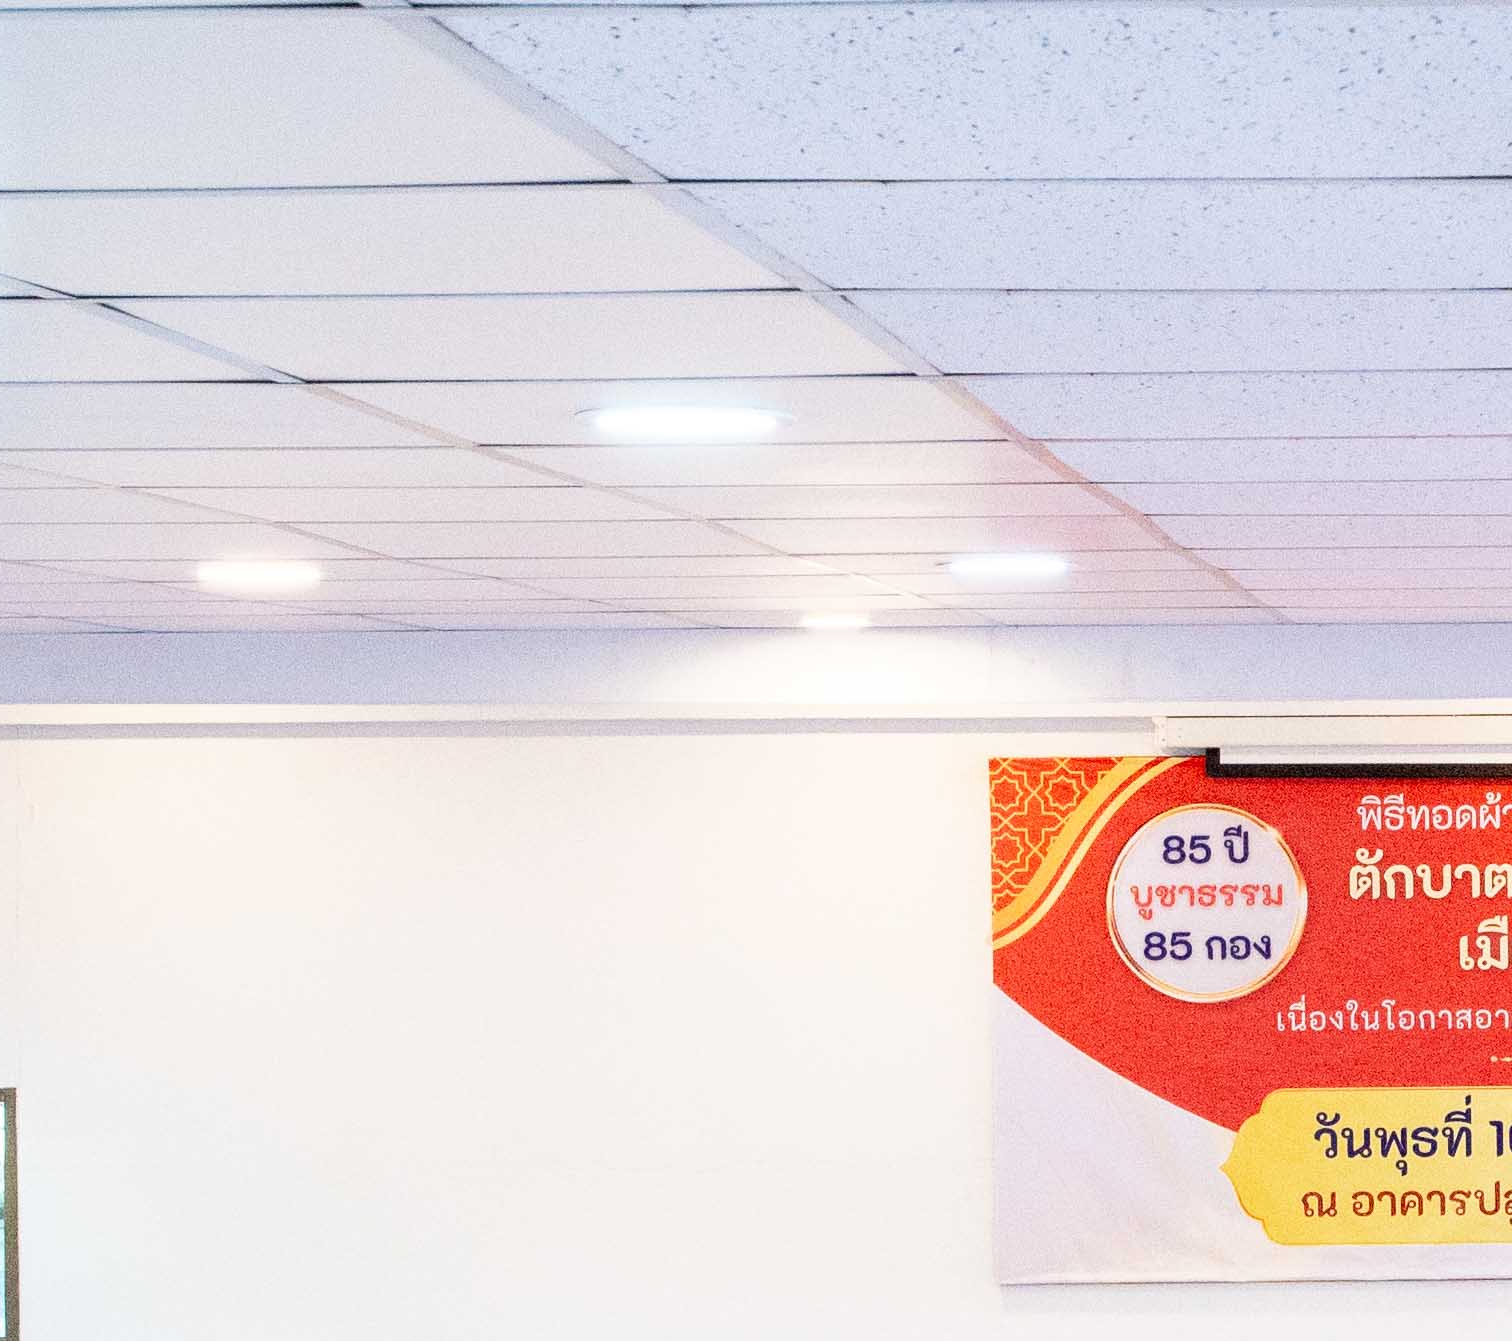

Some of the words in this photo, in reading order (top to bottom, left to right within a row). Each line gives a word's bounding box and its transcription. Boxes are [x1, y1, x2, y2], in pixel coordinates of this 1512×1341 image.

[1162, 834, 1212, 865] 85
[1223, 824, 1250, 865] ปี
[1129, 882, 1284, 921] บูชาธรรม
[1143, 931, 1193, 962] 85
[1205, 934, 1272, 961] กอง
[1313, 1094, 1473, 1177] วันพุธที่
[1300, 1190, 1338, 1218] ณ
